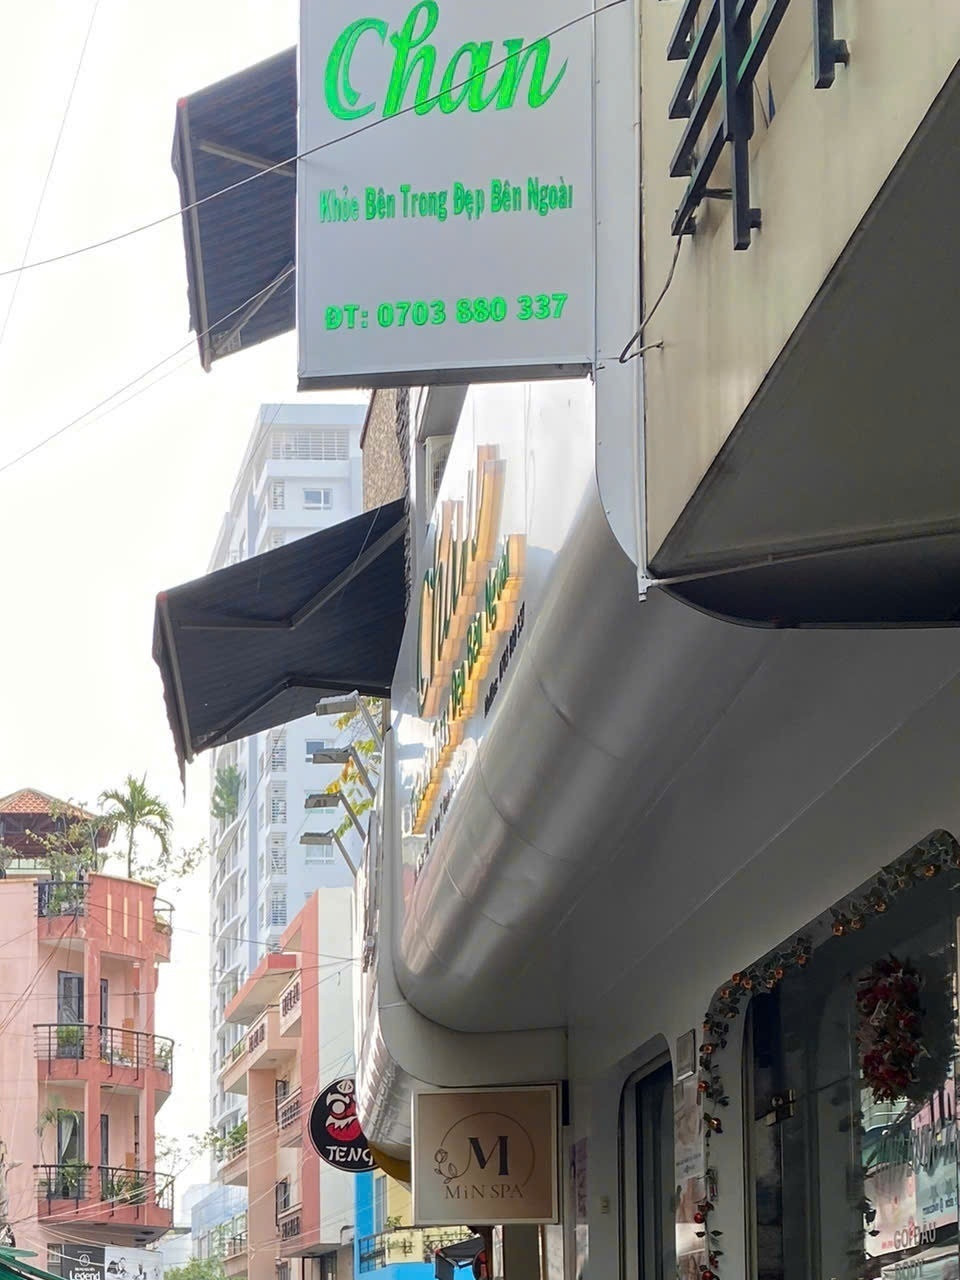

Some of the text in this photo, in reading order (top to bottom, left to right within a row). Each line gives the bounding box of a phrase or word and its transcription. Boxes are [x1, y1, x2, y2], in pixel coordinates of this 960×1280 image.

[319, 175, 573, 223] Khỏe Bên Trong Đẹp Bên Ngoài
[325, 293, 568, 330] ĐT: 0703 880 337
[468, 1135, 509, 1175] M
[490, 1183, 525, 1200] SPA
